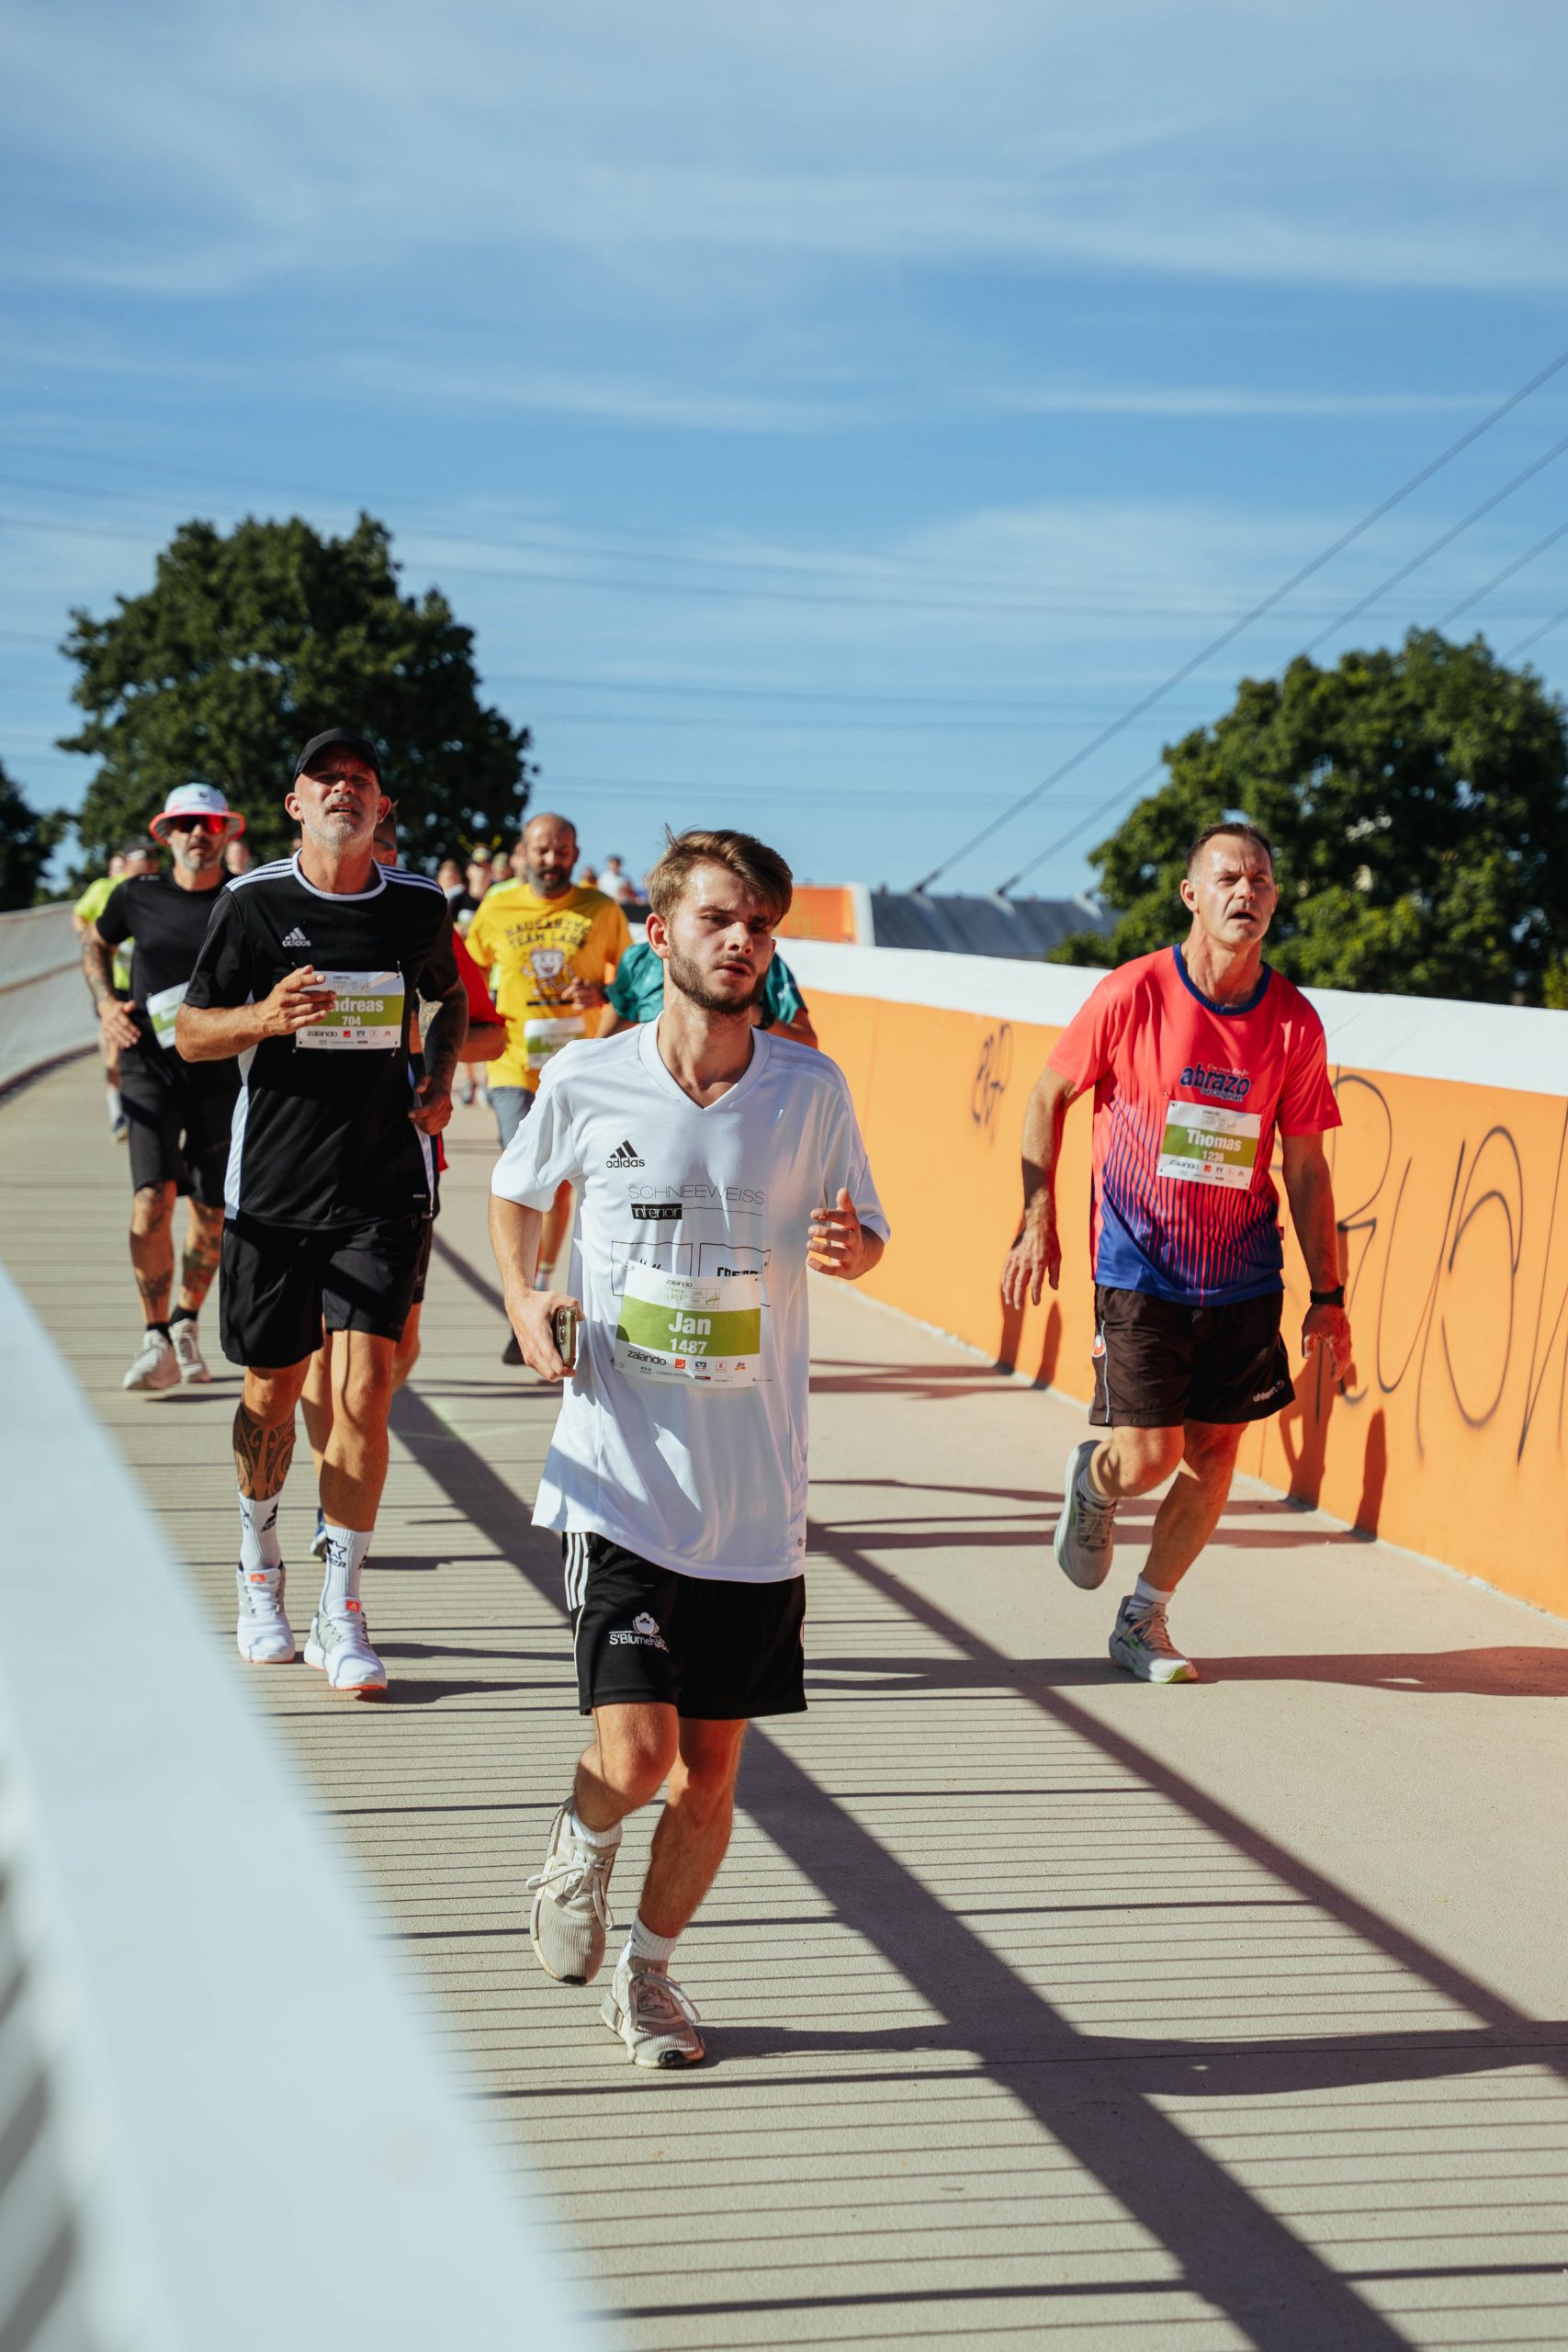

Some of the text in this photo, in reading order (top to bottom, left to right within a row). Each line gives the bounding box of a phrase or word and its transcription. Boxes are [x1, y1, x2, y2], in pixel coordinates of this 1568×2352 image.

[342, 1015, 361, 1026] 704
[1179, 1062, 1251, 1096] abrazo
[1187, 1128, 1242, 1152] Thomas
[605, 1157, 646, 1169] adidas
[627, 1184, 765, 1205] SCHNEEWEISS
[632, 1204, 682, 1219] interior
[668, 1311, 711, 1336] Jan
[670, 1338, 707, 1355] 1487
[626, 1350, 667, 1366] zalando
